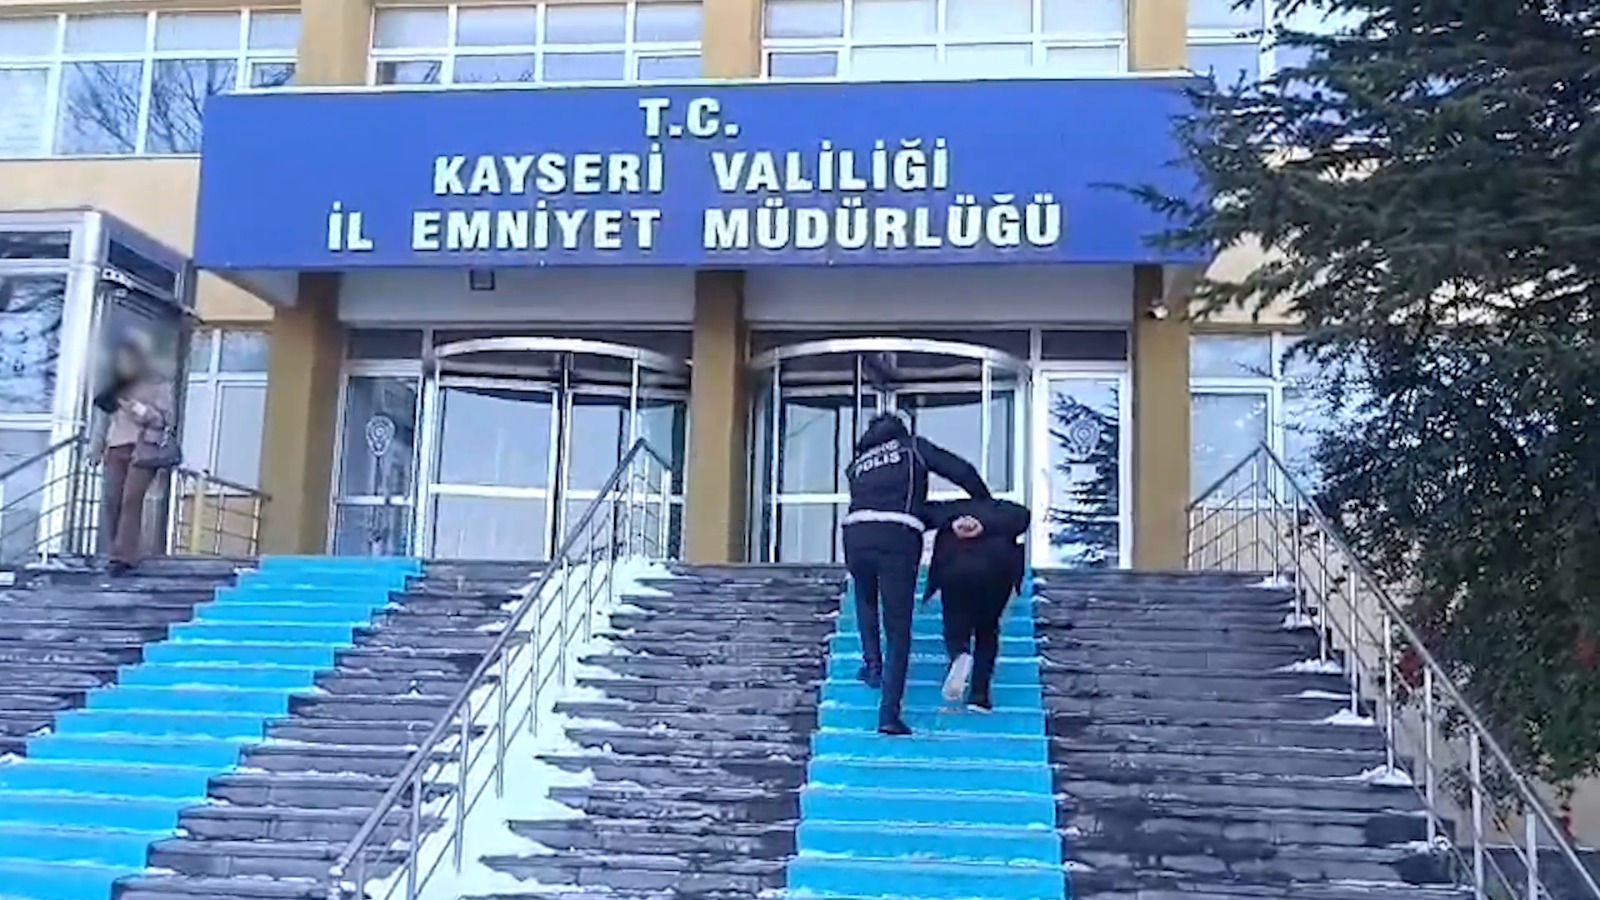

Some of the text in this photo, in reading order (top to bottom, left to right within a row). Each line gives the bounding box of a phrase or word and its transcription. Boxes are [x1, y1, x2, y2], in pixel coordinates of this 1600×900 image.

[638, 97, 740, 138] T.C.
[433, 138, 949, 195] KAYSERİ VALİLİĞİ
[327, 193, 1062, 251] İL EMNİYET MÜDÜRLÜĞÜ
